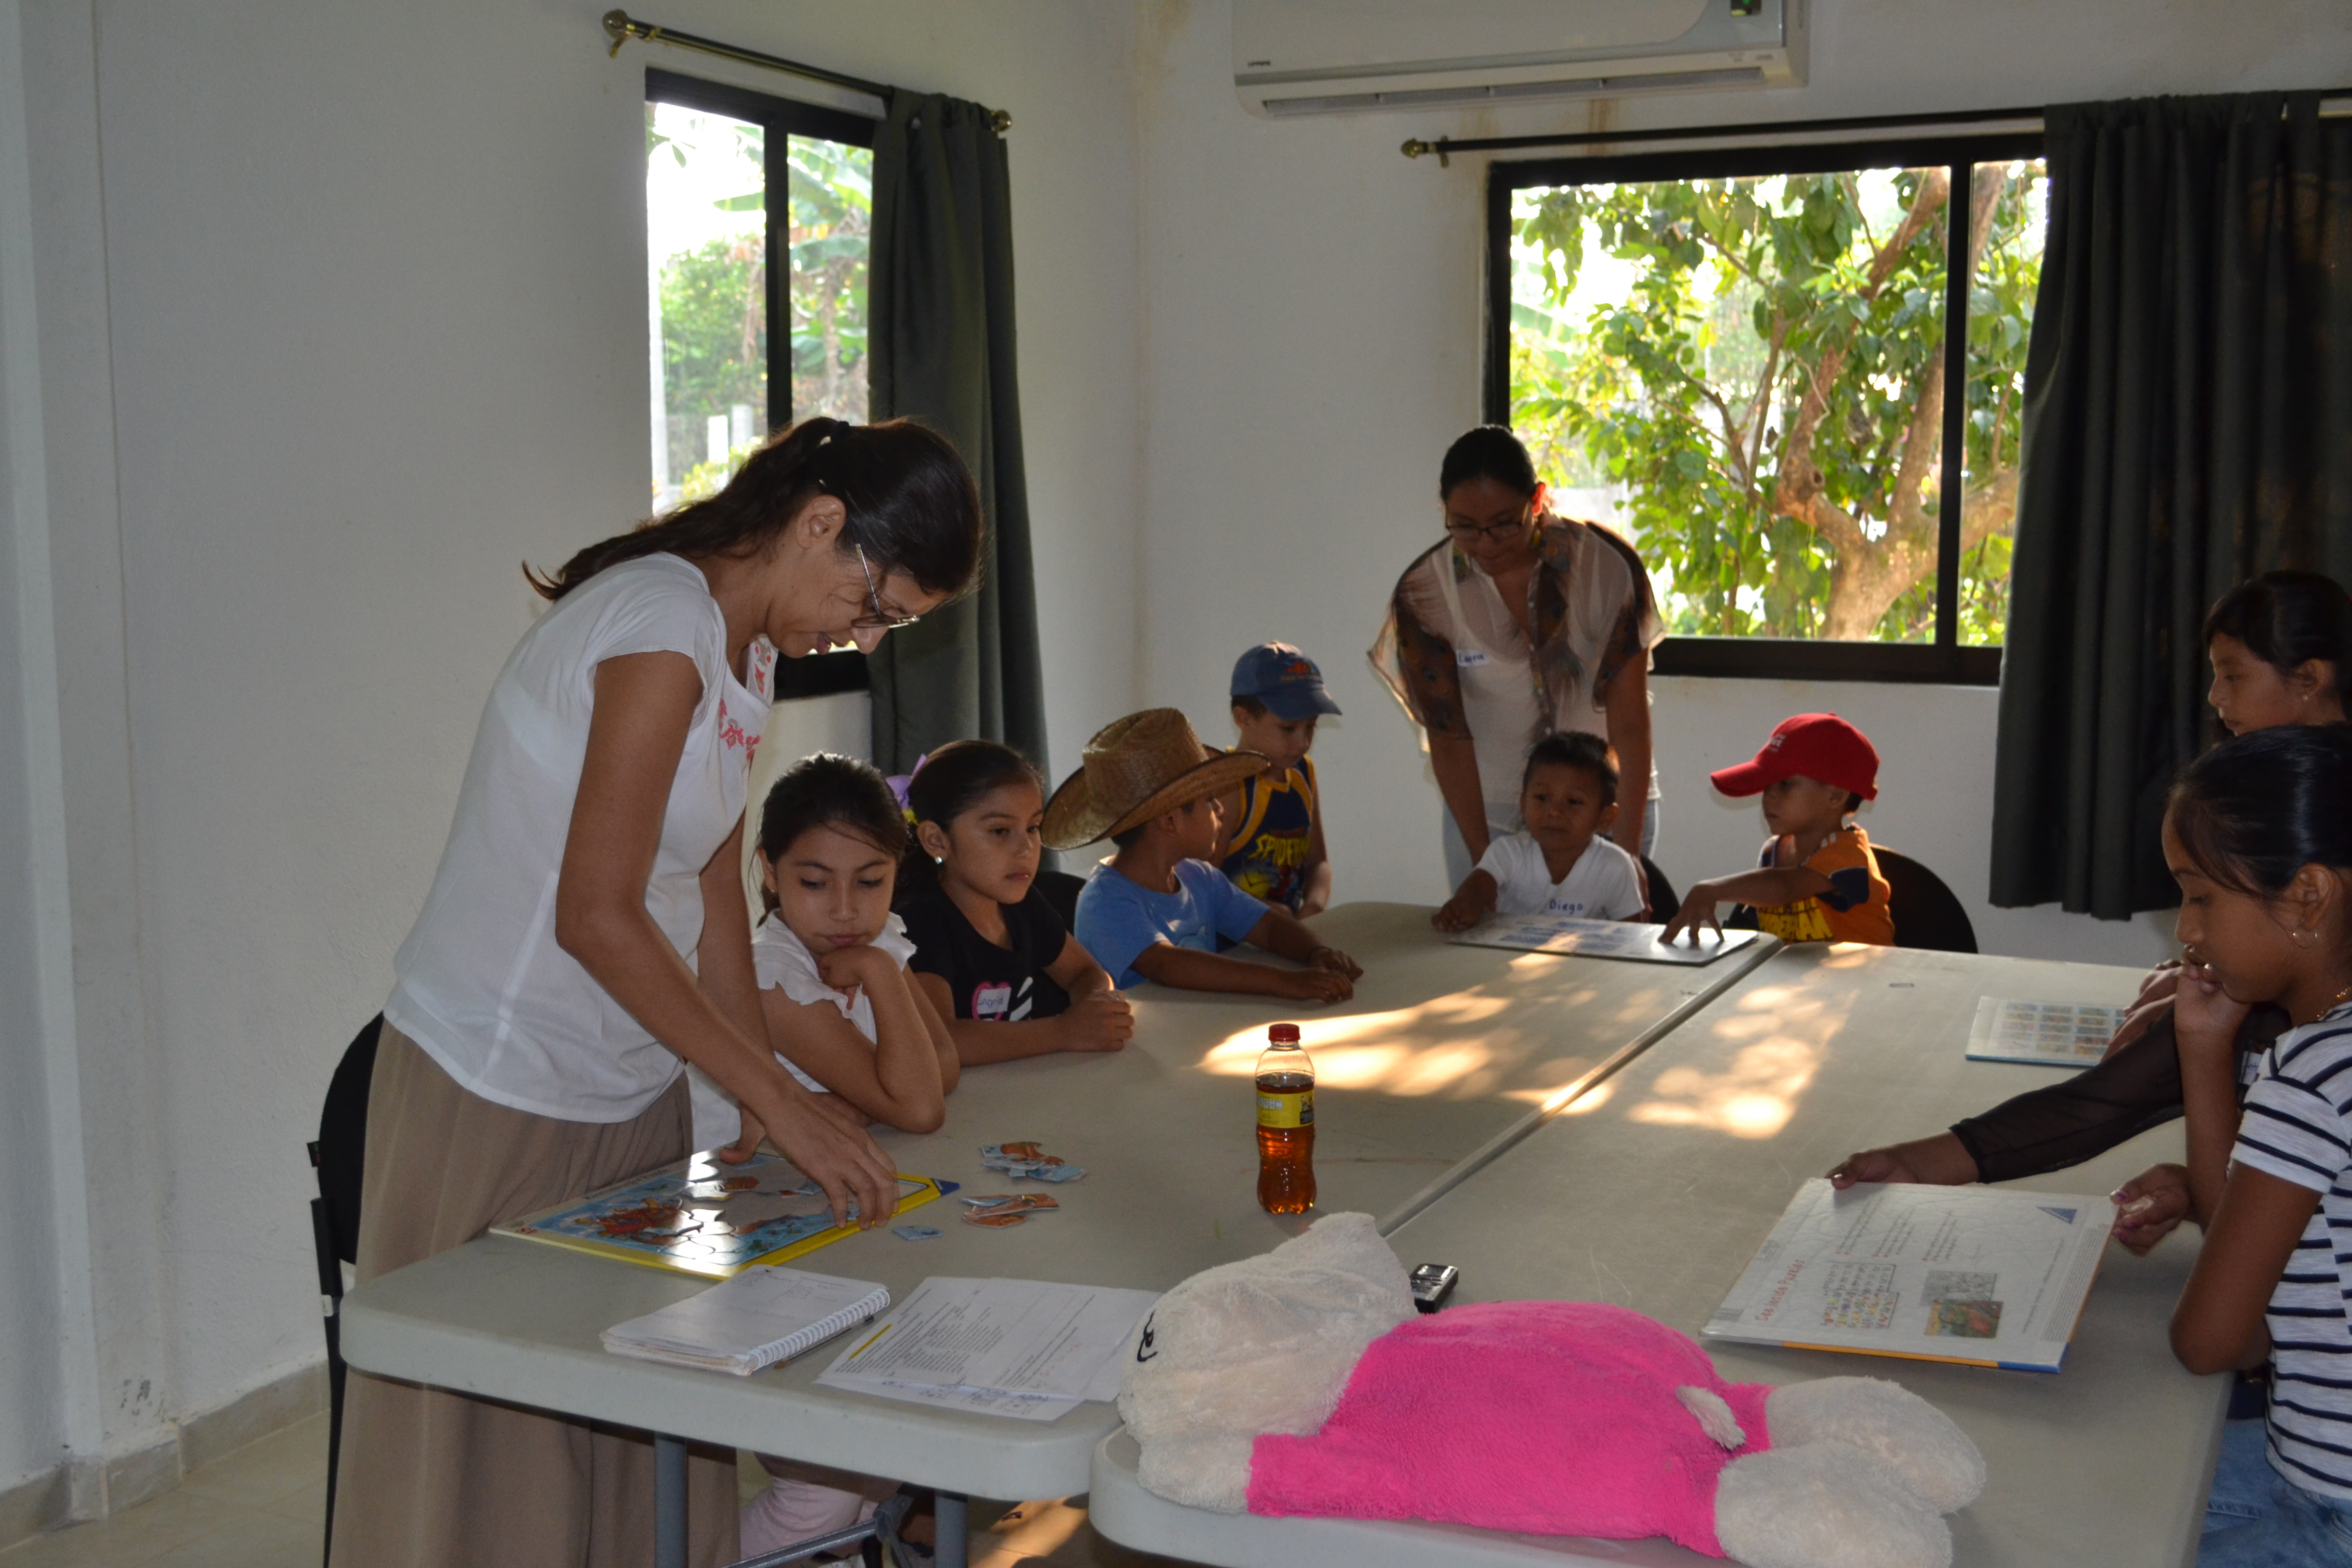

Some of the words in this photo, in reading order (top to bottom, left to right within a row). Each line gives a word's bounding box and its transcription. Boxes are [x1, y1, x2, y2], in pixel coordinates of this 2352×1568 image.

[1549, 898, 1584, 915] Diego
[1777, 1259, 1806, 1285] Puzzles
[1763, 1286, 1788, 1307] Inside
[1755, 1307, 1774, 1321] See
